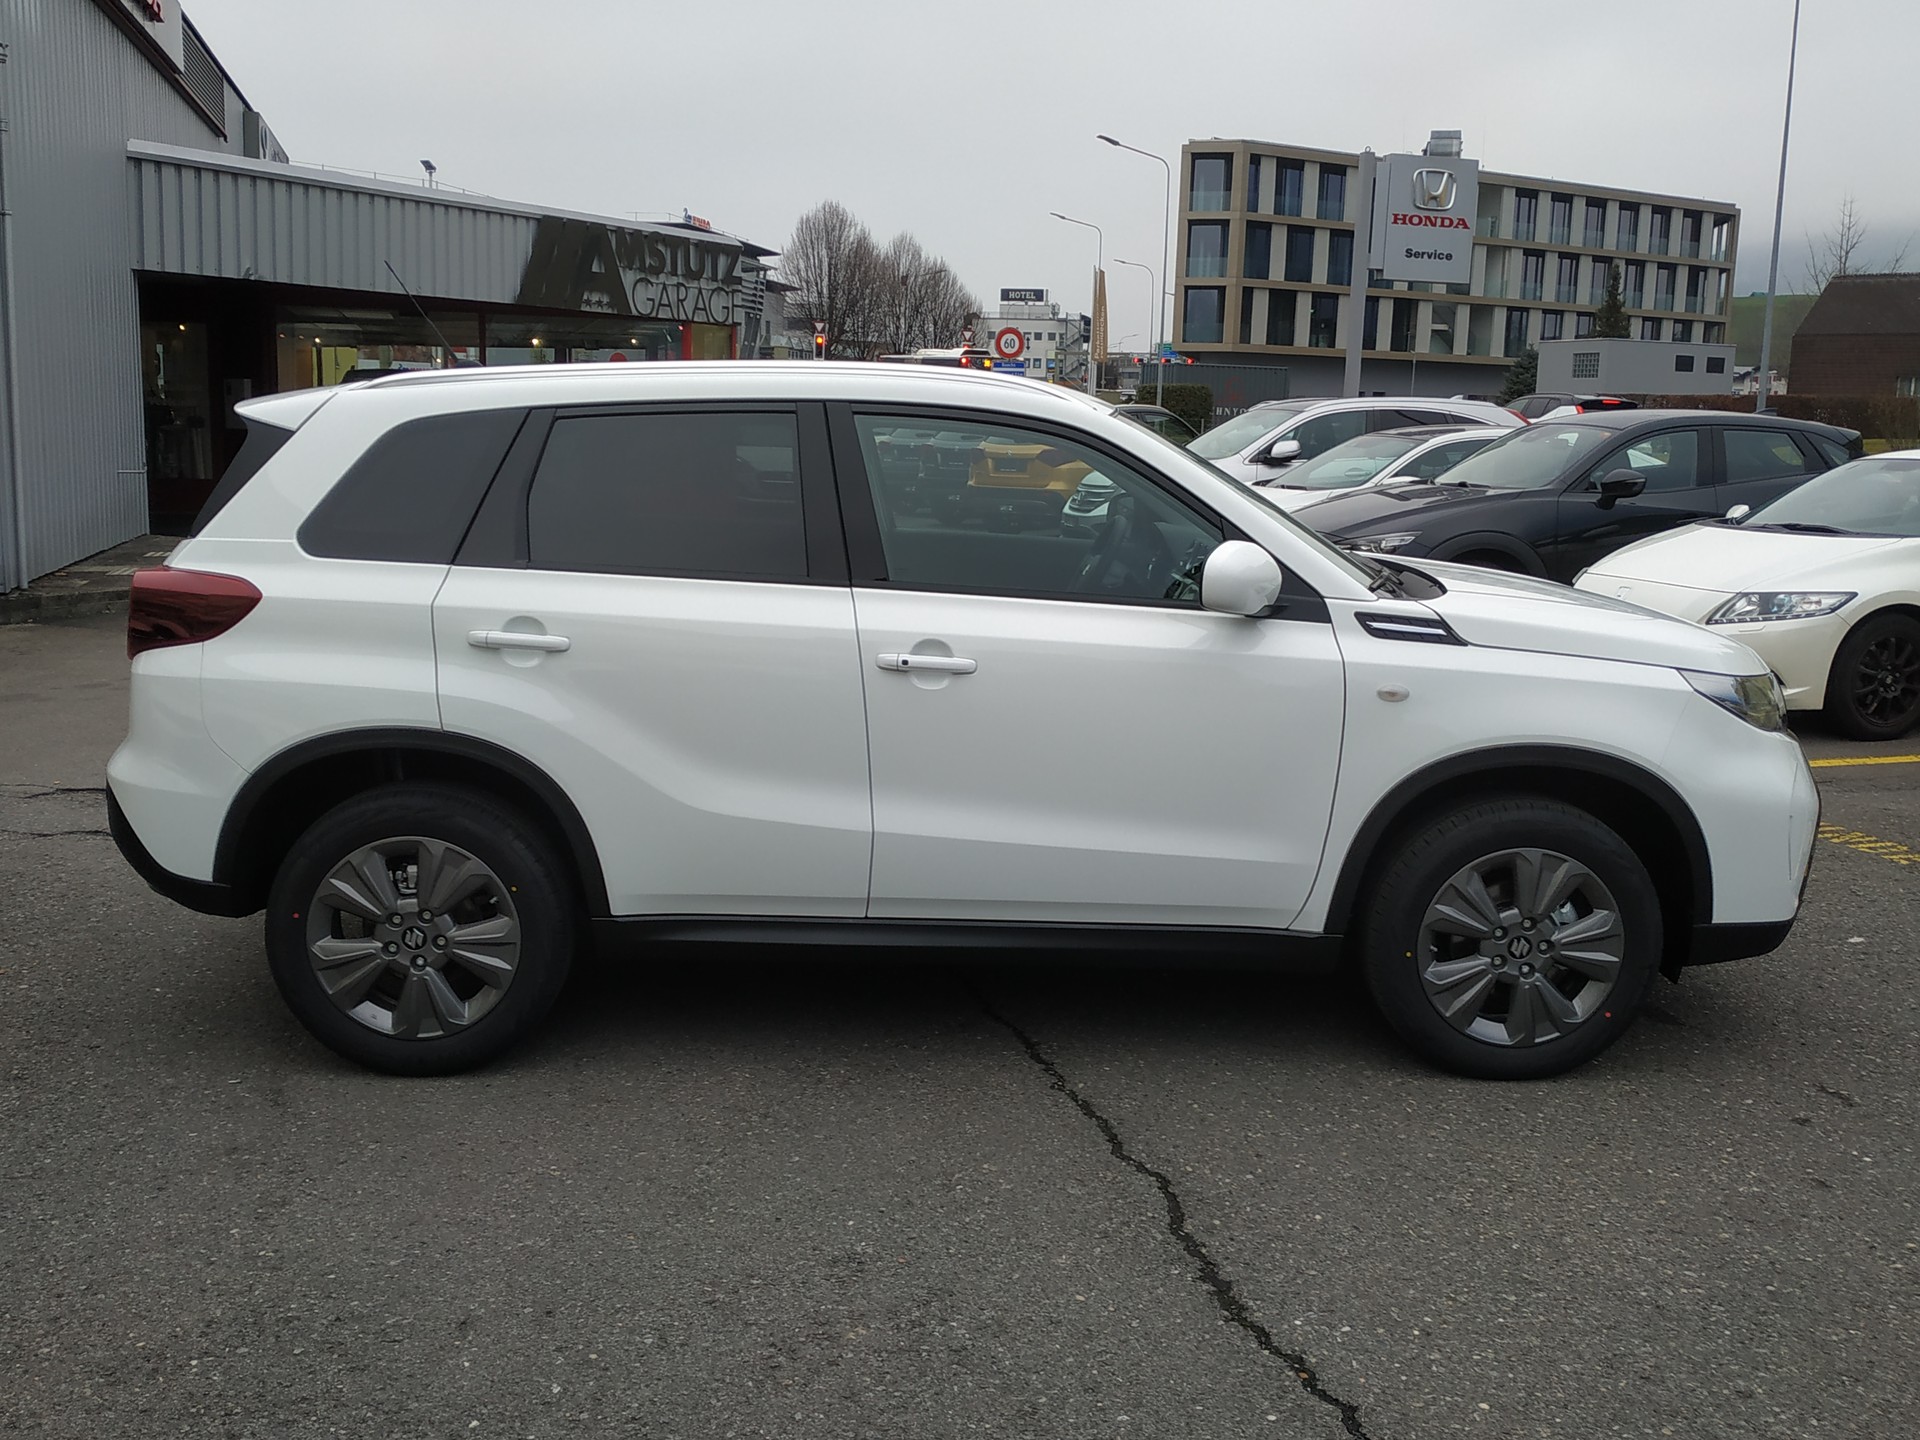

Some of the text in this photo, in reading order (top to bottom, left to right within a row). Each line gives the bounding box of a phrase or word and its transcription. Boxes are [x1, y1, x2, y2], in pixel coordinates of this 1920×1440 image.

[1391, 213, 1470, 230] HONDA
[1405, 247, 1453, 261] Service
[572, 223, 743, 315] AMSTUTZ
[632, 277, 743, 326] GARAGE
[1008, 291, 1036, 299] HOTEL
[1003, 338, 1016, 349] 60
